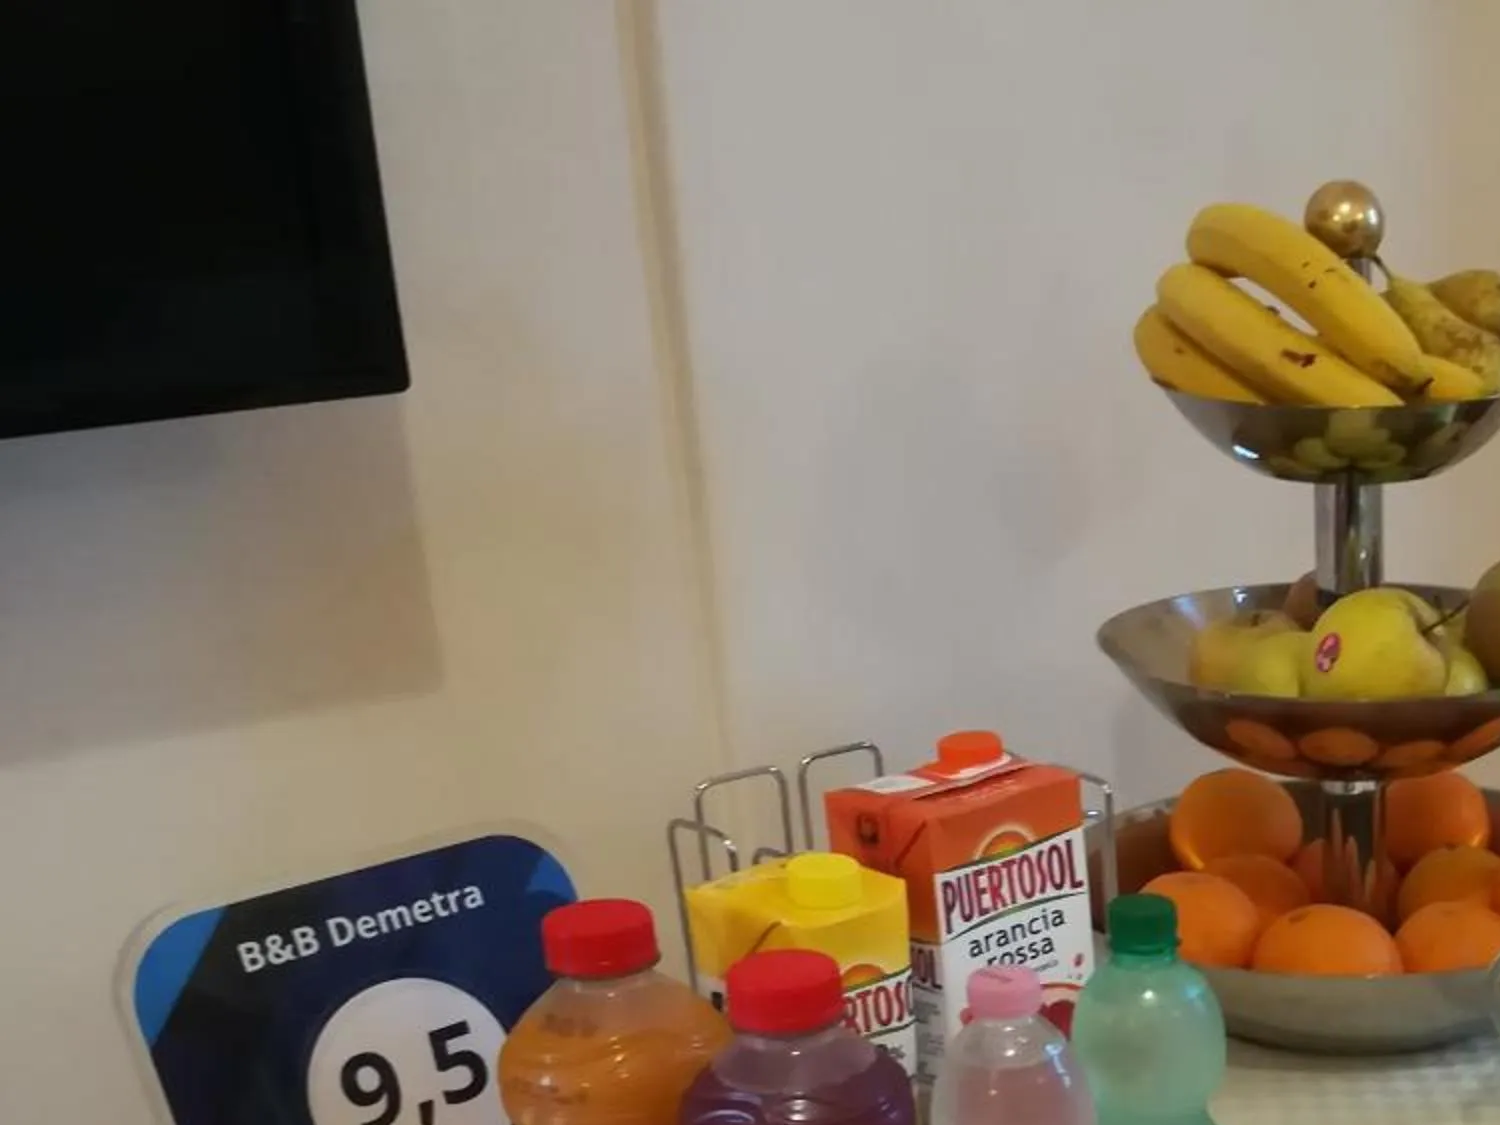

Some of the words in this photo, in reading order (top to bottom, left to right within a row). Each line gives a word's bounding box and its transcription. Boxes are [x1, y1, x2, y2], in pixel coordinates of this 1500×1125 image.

[237, 925, 320, 973] B&B
[325, 885, 485, 947] Demetra
[940, 838, 1085, 935] PUERTOSOL
[968, 907, 1066, 959] arancia
